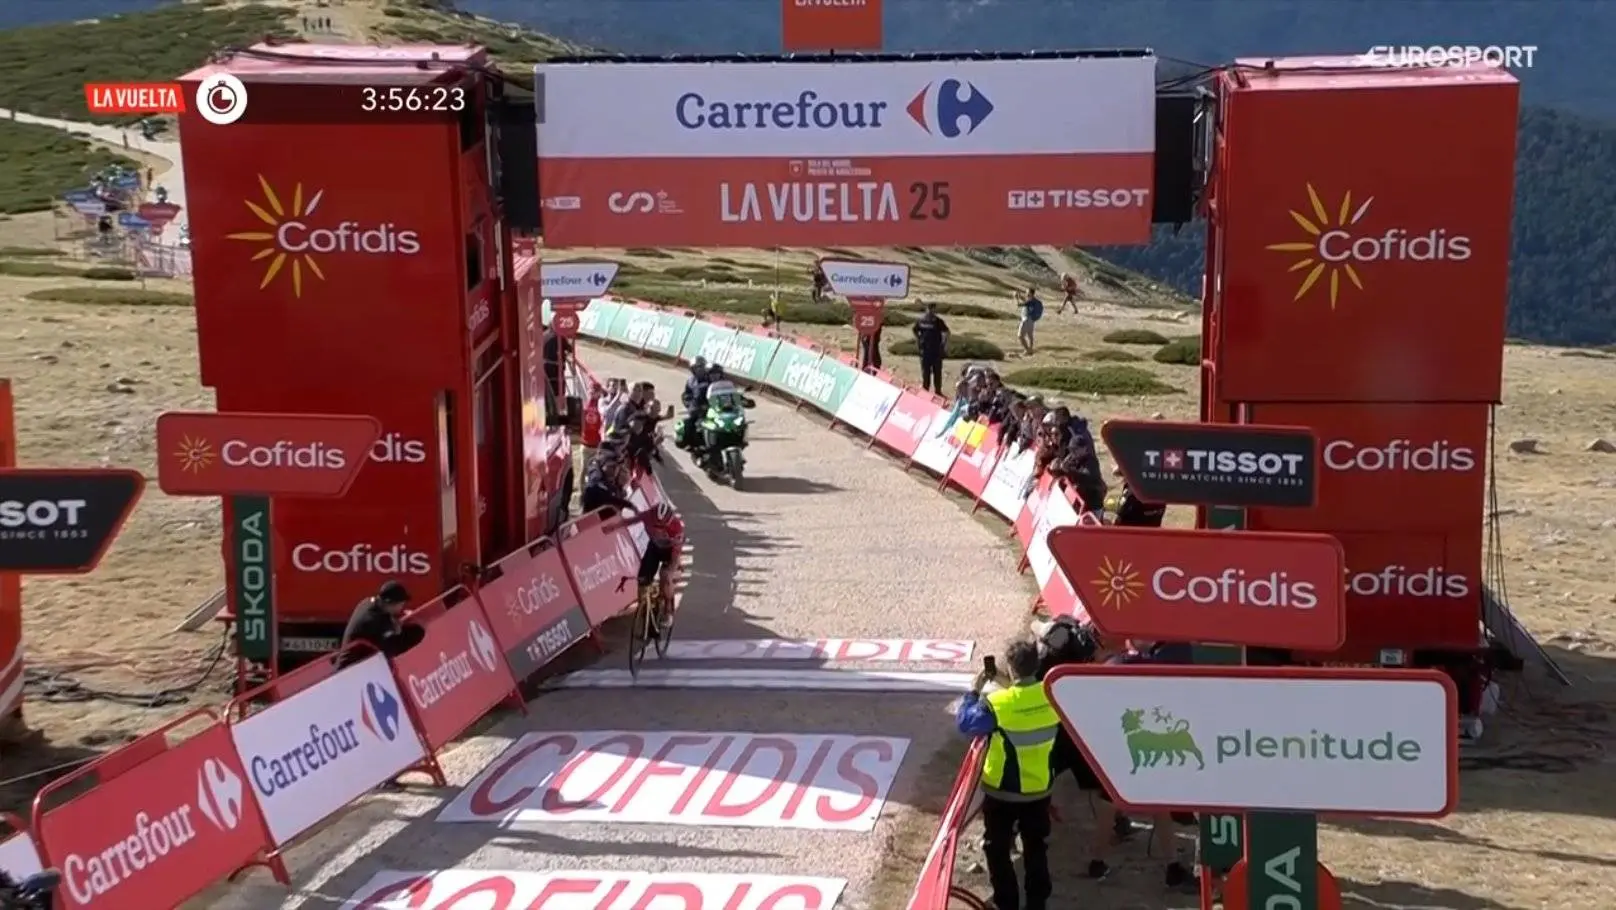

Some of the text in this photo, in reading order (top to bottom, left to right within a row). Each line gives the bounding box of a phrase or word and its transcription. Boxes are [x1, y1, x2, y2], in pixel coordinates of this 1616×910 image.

[675, 91, 887, 130] Carrefour
[720, 182, 951, 222] LA VUELTA 25
[1048, 189, 1149, 208] TISSOT
[278, 222, 420, 254] Cofidis
[1318, 228, 1472, 261] Cofidis
[541, 276, 582, 286] rrefour
[831, 272, 880, 285] Carrefour
[559, 316, 574, 329] 25
[860, 315, 875, 327] 25
[222, 440, 345, 469] Cofidis
[1187, 450, 1304, 476] TISSOT
[1323, 439, 1475, 472] Cofidis
[0, 499, 87, 527] SOT
[292, 543, 431, 575] Cofidis
[1152, 566, 1318, 609] Cofidis
[1345, 564, 1469, 598] ofidis
[407, 650, 474, 710] Carrefour
[251, 717, 360, 798] Carrefour
[1217, 728, 1422, 764] plenitude
[468, 734, 895, 822] COFIDIS
[64, 803, 197, 905] Carrefour
